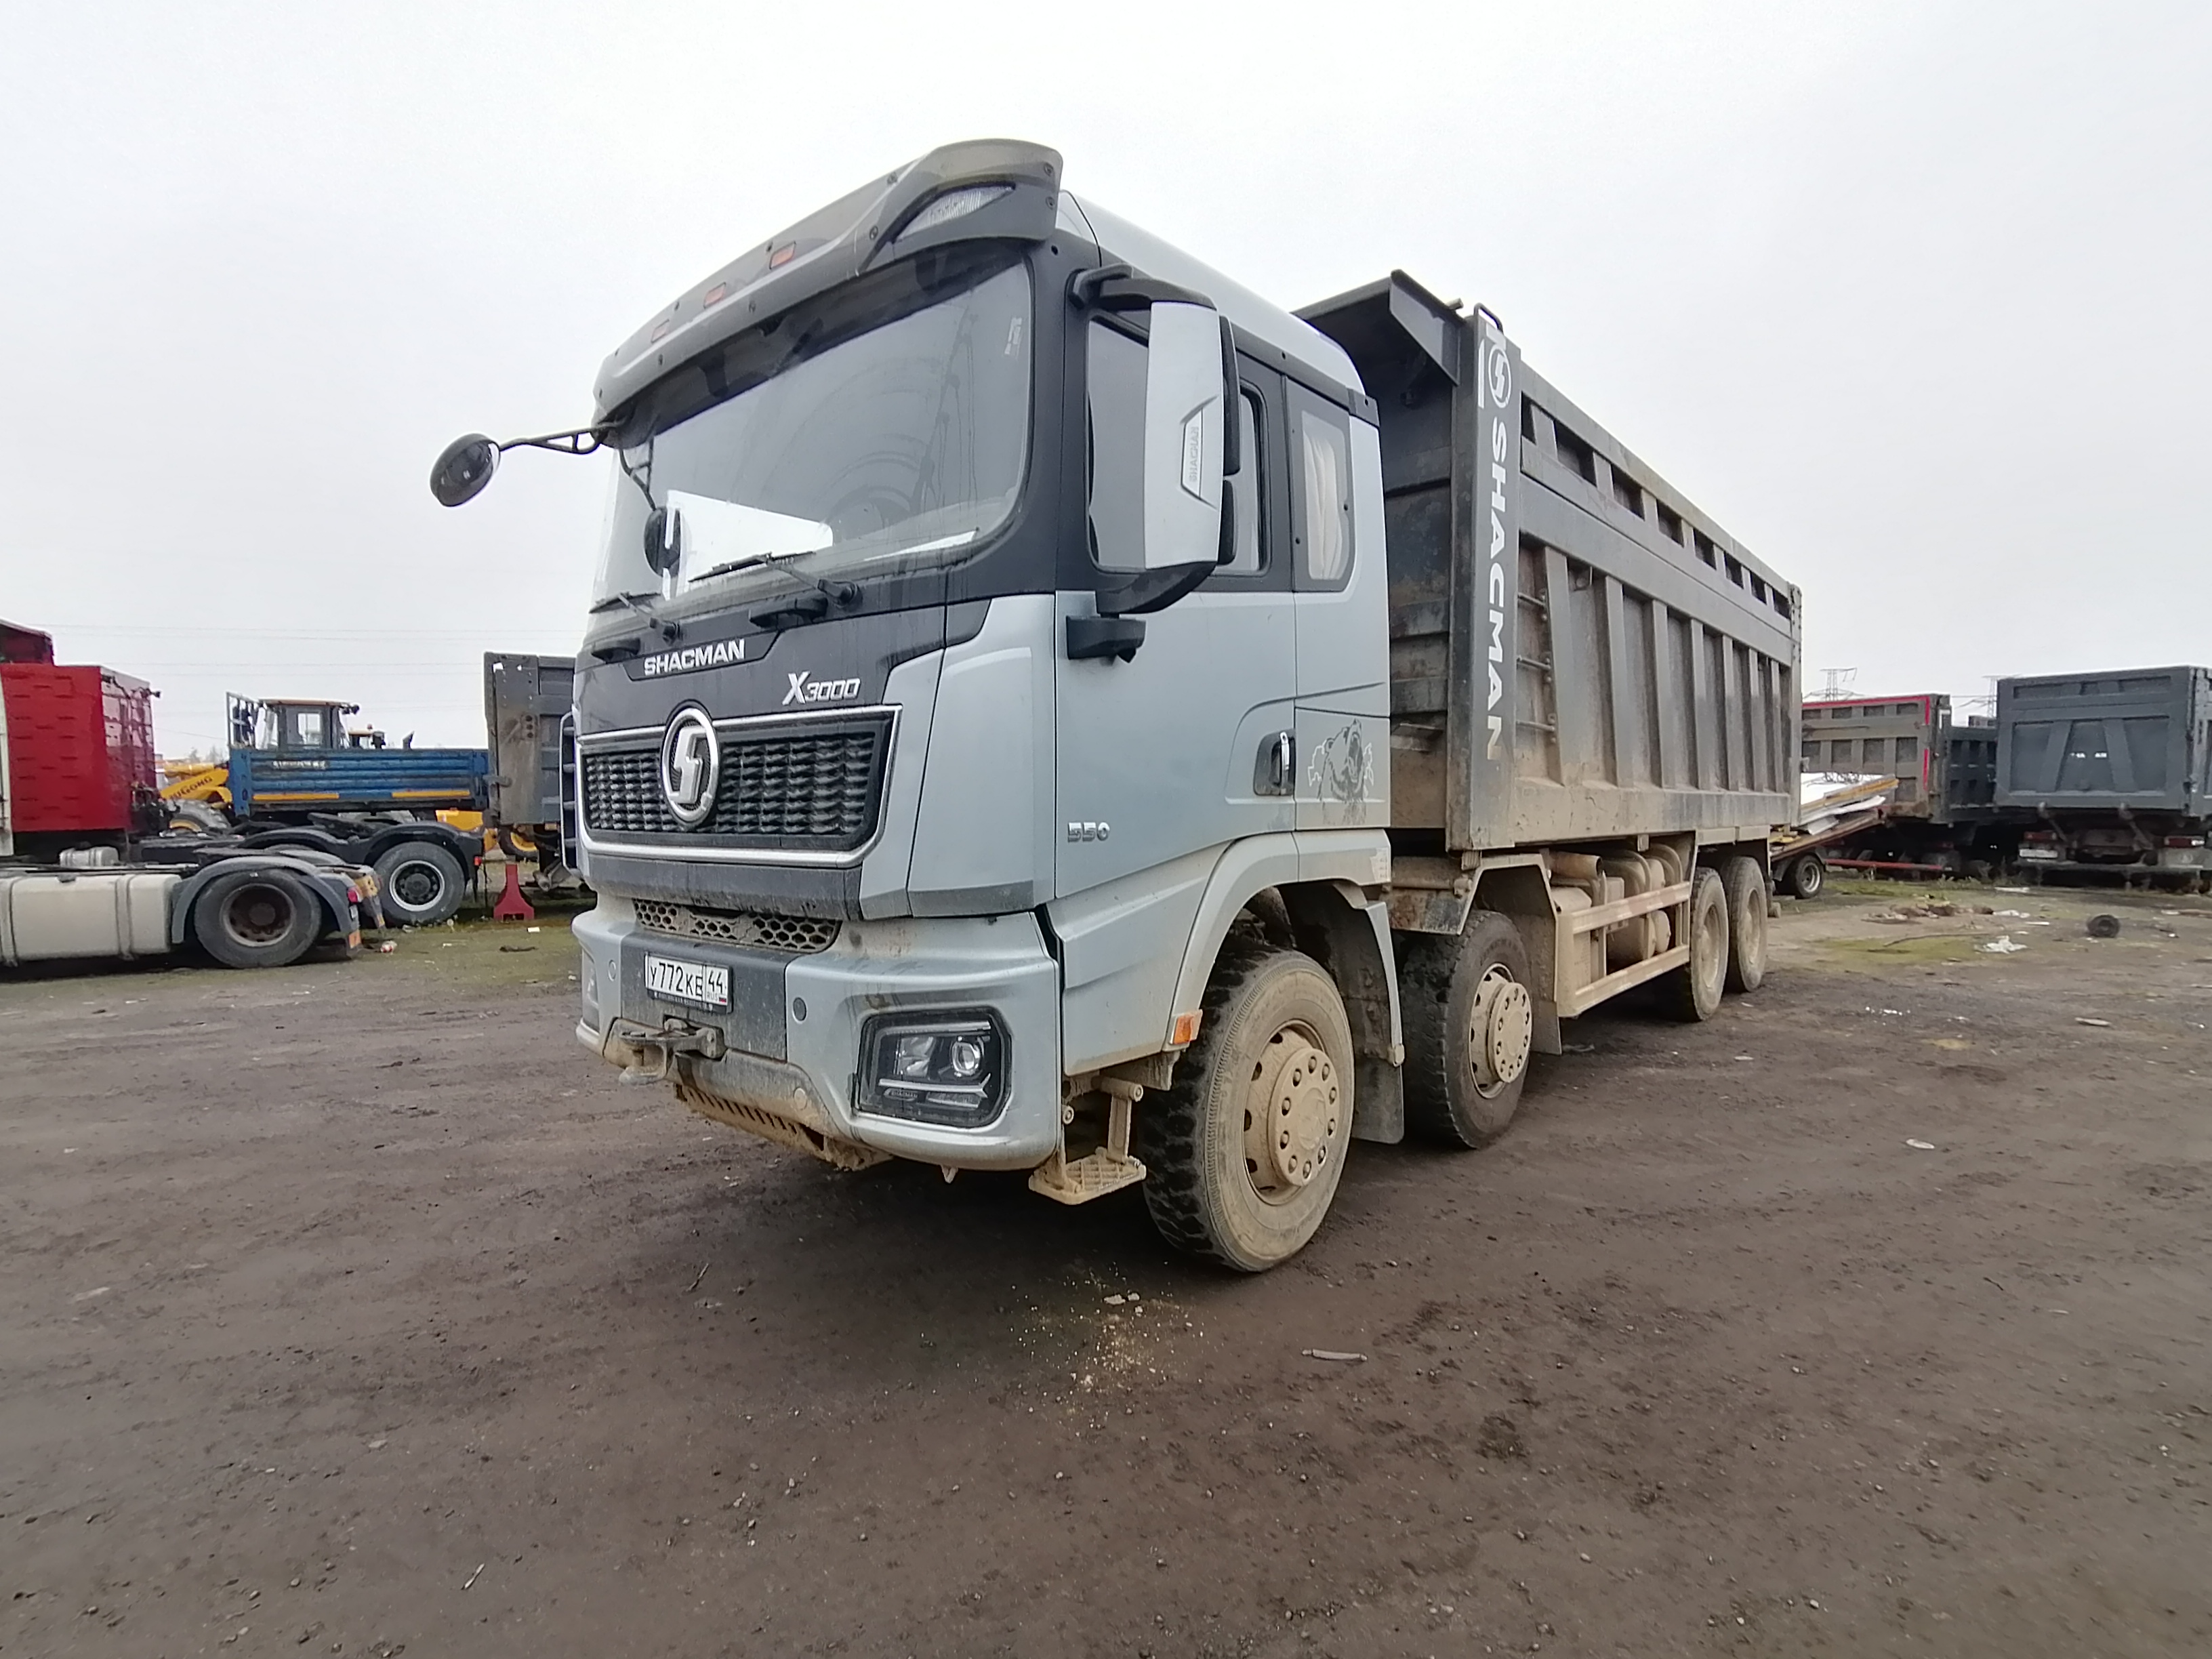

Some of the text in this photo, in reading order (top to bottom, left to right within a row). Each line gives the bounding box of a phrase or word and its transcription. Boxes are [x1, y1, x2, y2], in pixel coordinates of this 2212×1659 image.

[1189, 426, 1199, 482] SHACMAN
[1487, 416, 1507, 760] SHACMAN
[644, 639, 745, 676] SHACMAN
[782, 670, 861, 705] X3000
[1067, 821, 1110, 842] 550
[707, 991, 718, 1001] RUS
[708, 970, 723, 994] 44
